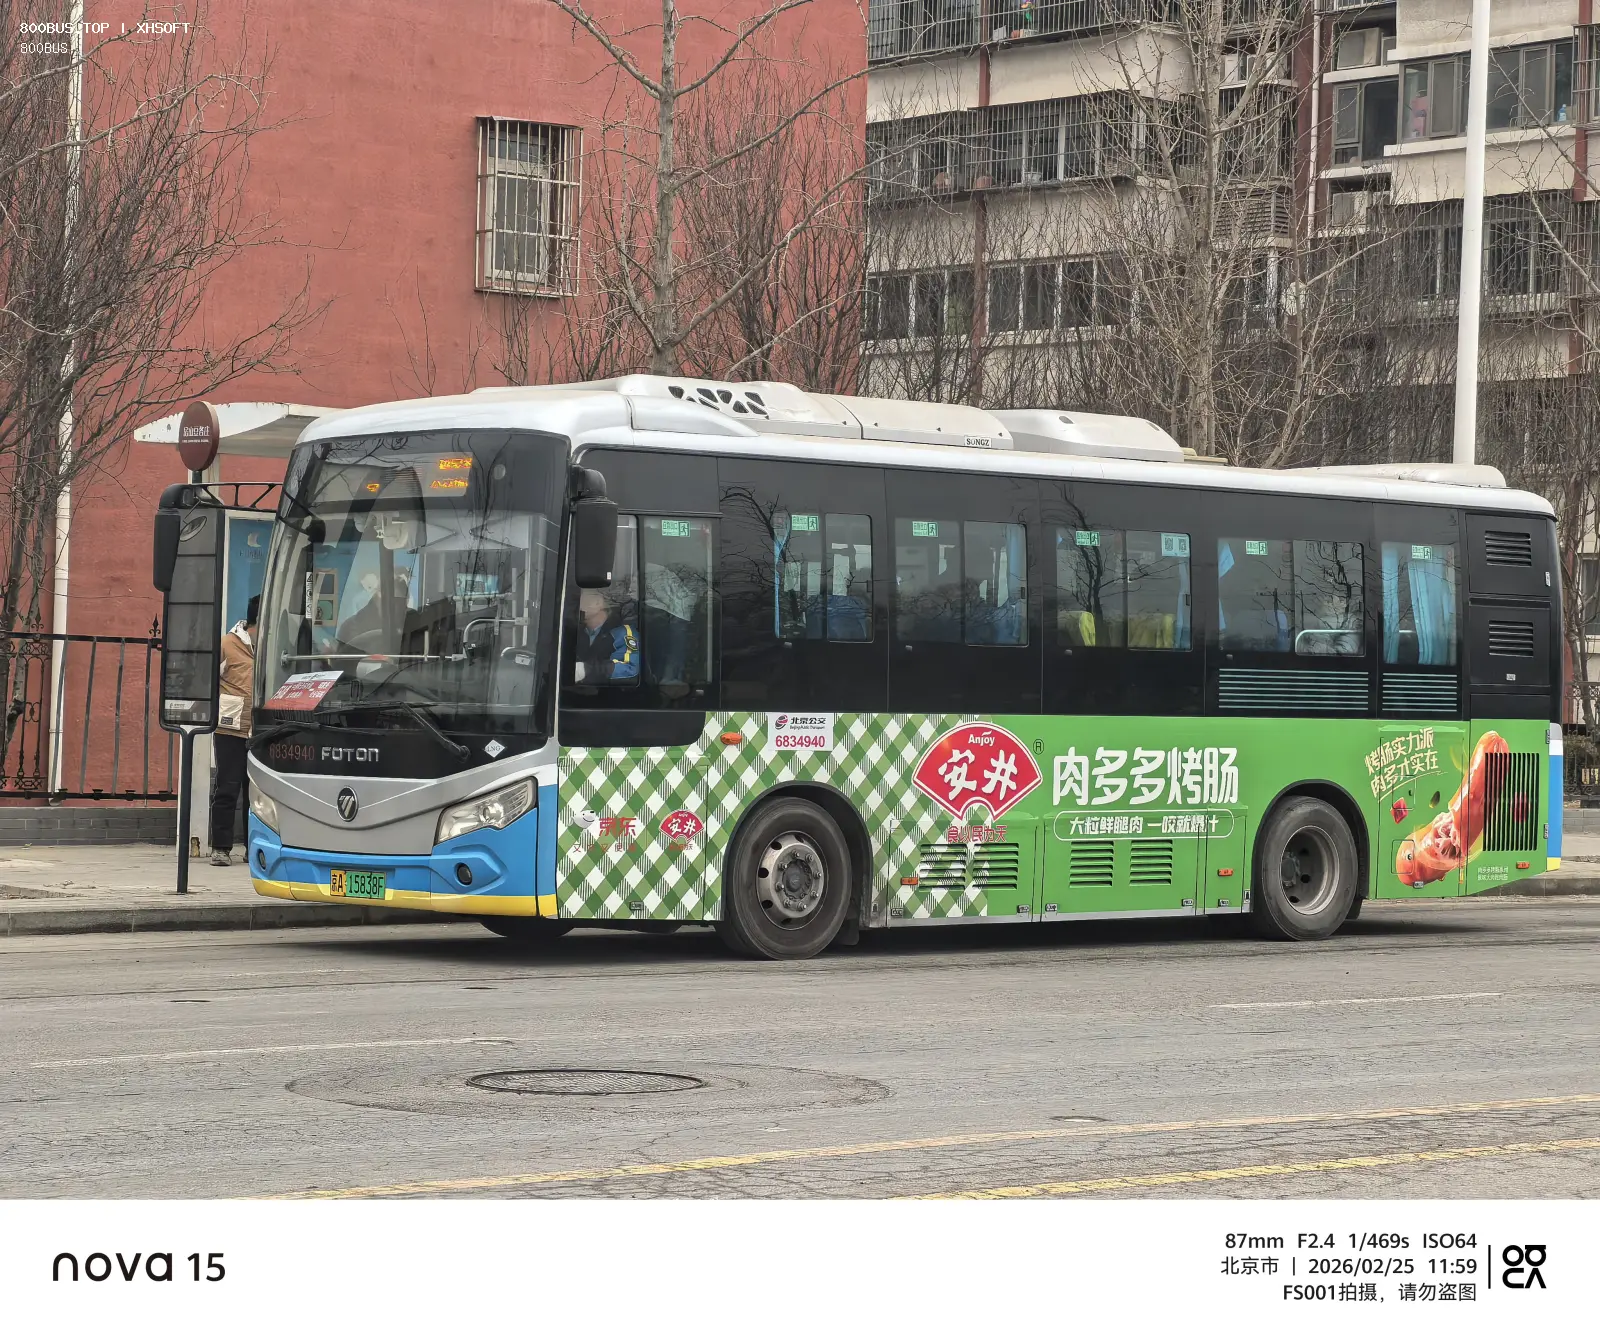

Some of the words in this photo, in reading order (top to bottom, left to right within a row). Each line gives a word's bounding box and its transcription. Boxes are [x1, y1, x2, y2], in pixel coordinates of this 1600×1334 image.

[966, 437, 990, 447] SONGZ
[790, 716, 827, 725] 北京公交
[775, 734, 826, 748] 6834940
[968, 731, 995, 747] Anjoy
[268, 742, 316, 761] 6834940
[321, 746, 380, 762] FOTON
[1364, 726, 1434, 776] 烤肠实力派
[937, 749, 1018, 801] 安井
[1052, 746, 1239, 806] 肉多多烤肠
[1370, 749, 1439, 798] 肉多才实在
[599, 816, 637, 836] 京东
[667, 818, 697, 835] 安井
[1069, 815, 1144, 835] 大粒鲜腿肉
[1147, 814, 1220, 834] 一咬就爆汁
[947, 825, 1008, 843] 食以民为天
